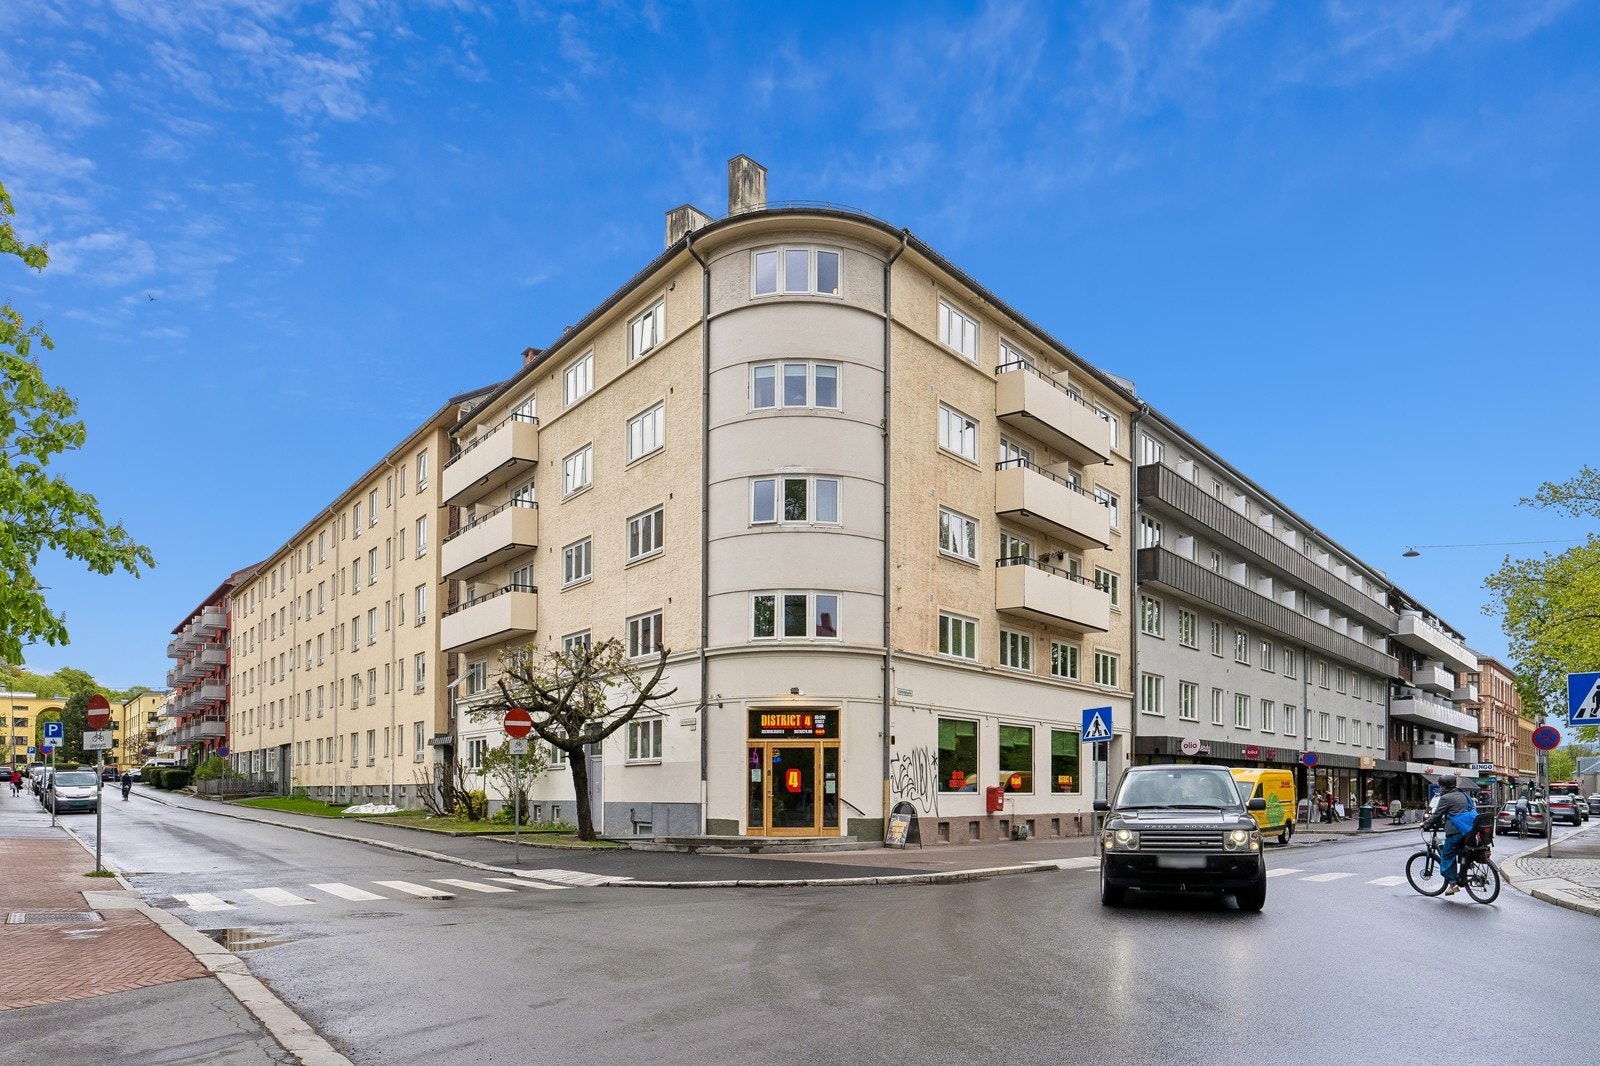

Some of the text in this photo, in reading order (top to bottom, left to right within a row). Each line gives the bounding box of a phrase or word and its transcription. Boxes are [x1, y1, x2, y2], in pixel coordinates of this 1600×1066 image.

[761, 714, 801, 726] DISTRICT
[805, 716, 811, 726] 4
[48, 724, 58, 736] P
[1183, 741, 1198, 749] olio
[788, 771, 799, 787] 4
